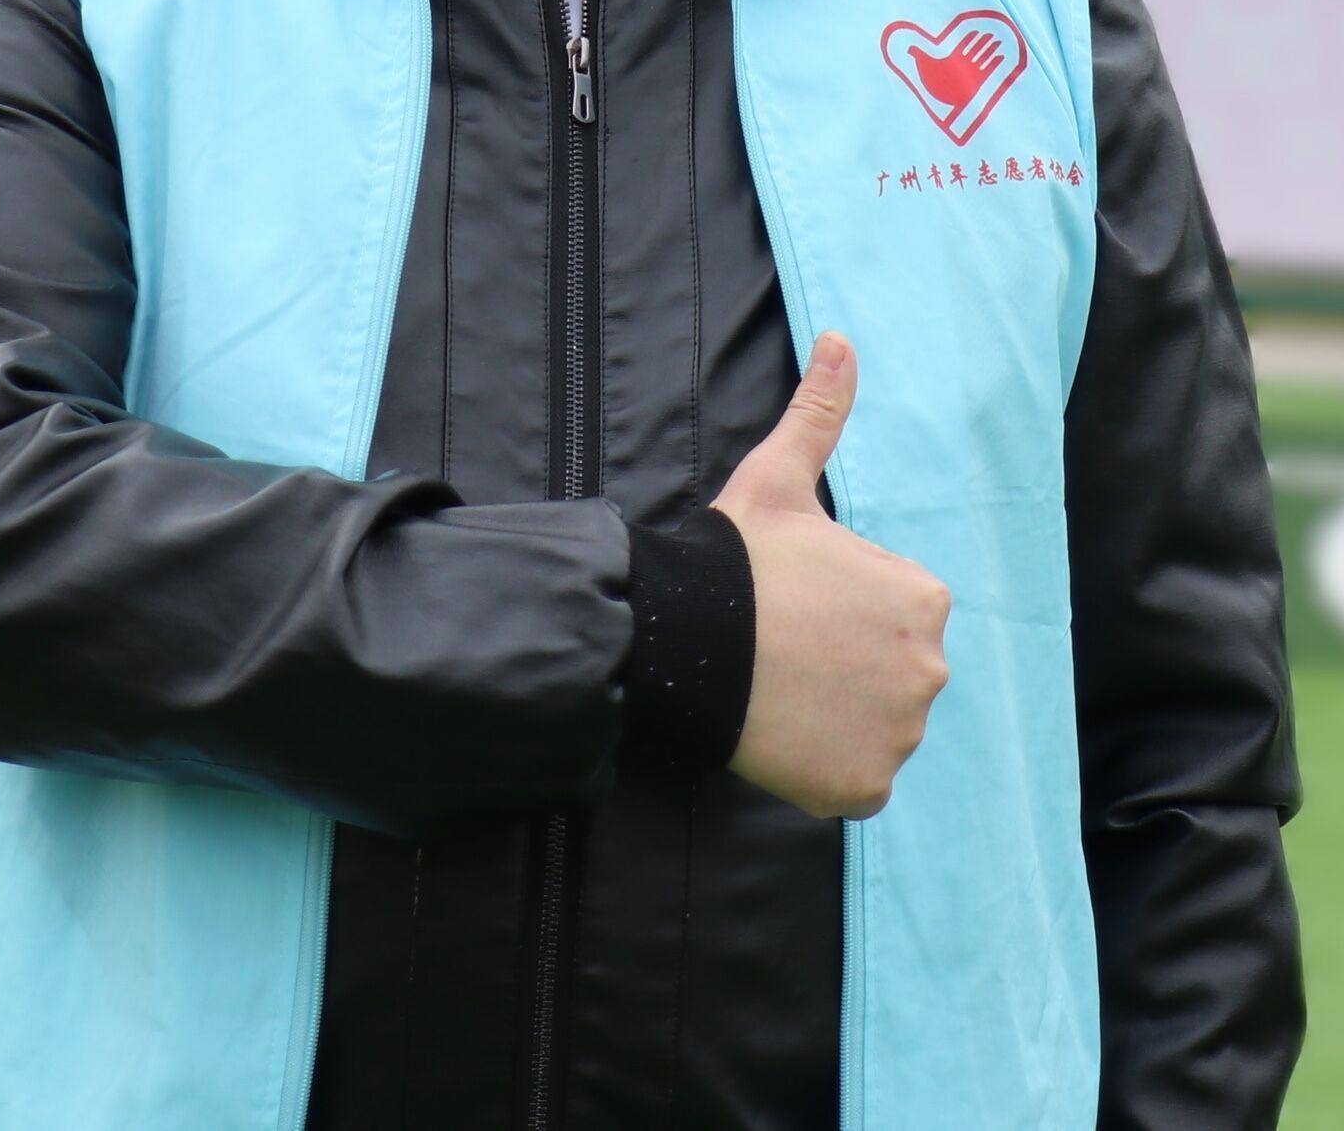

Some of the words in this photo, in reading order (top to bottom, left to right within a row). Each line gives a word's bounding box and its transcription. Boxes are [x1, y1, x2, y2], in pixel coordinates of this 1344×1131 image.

[876, 155, 1085, 198] 广州青年志愿者协会
